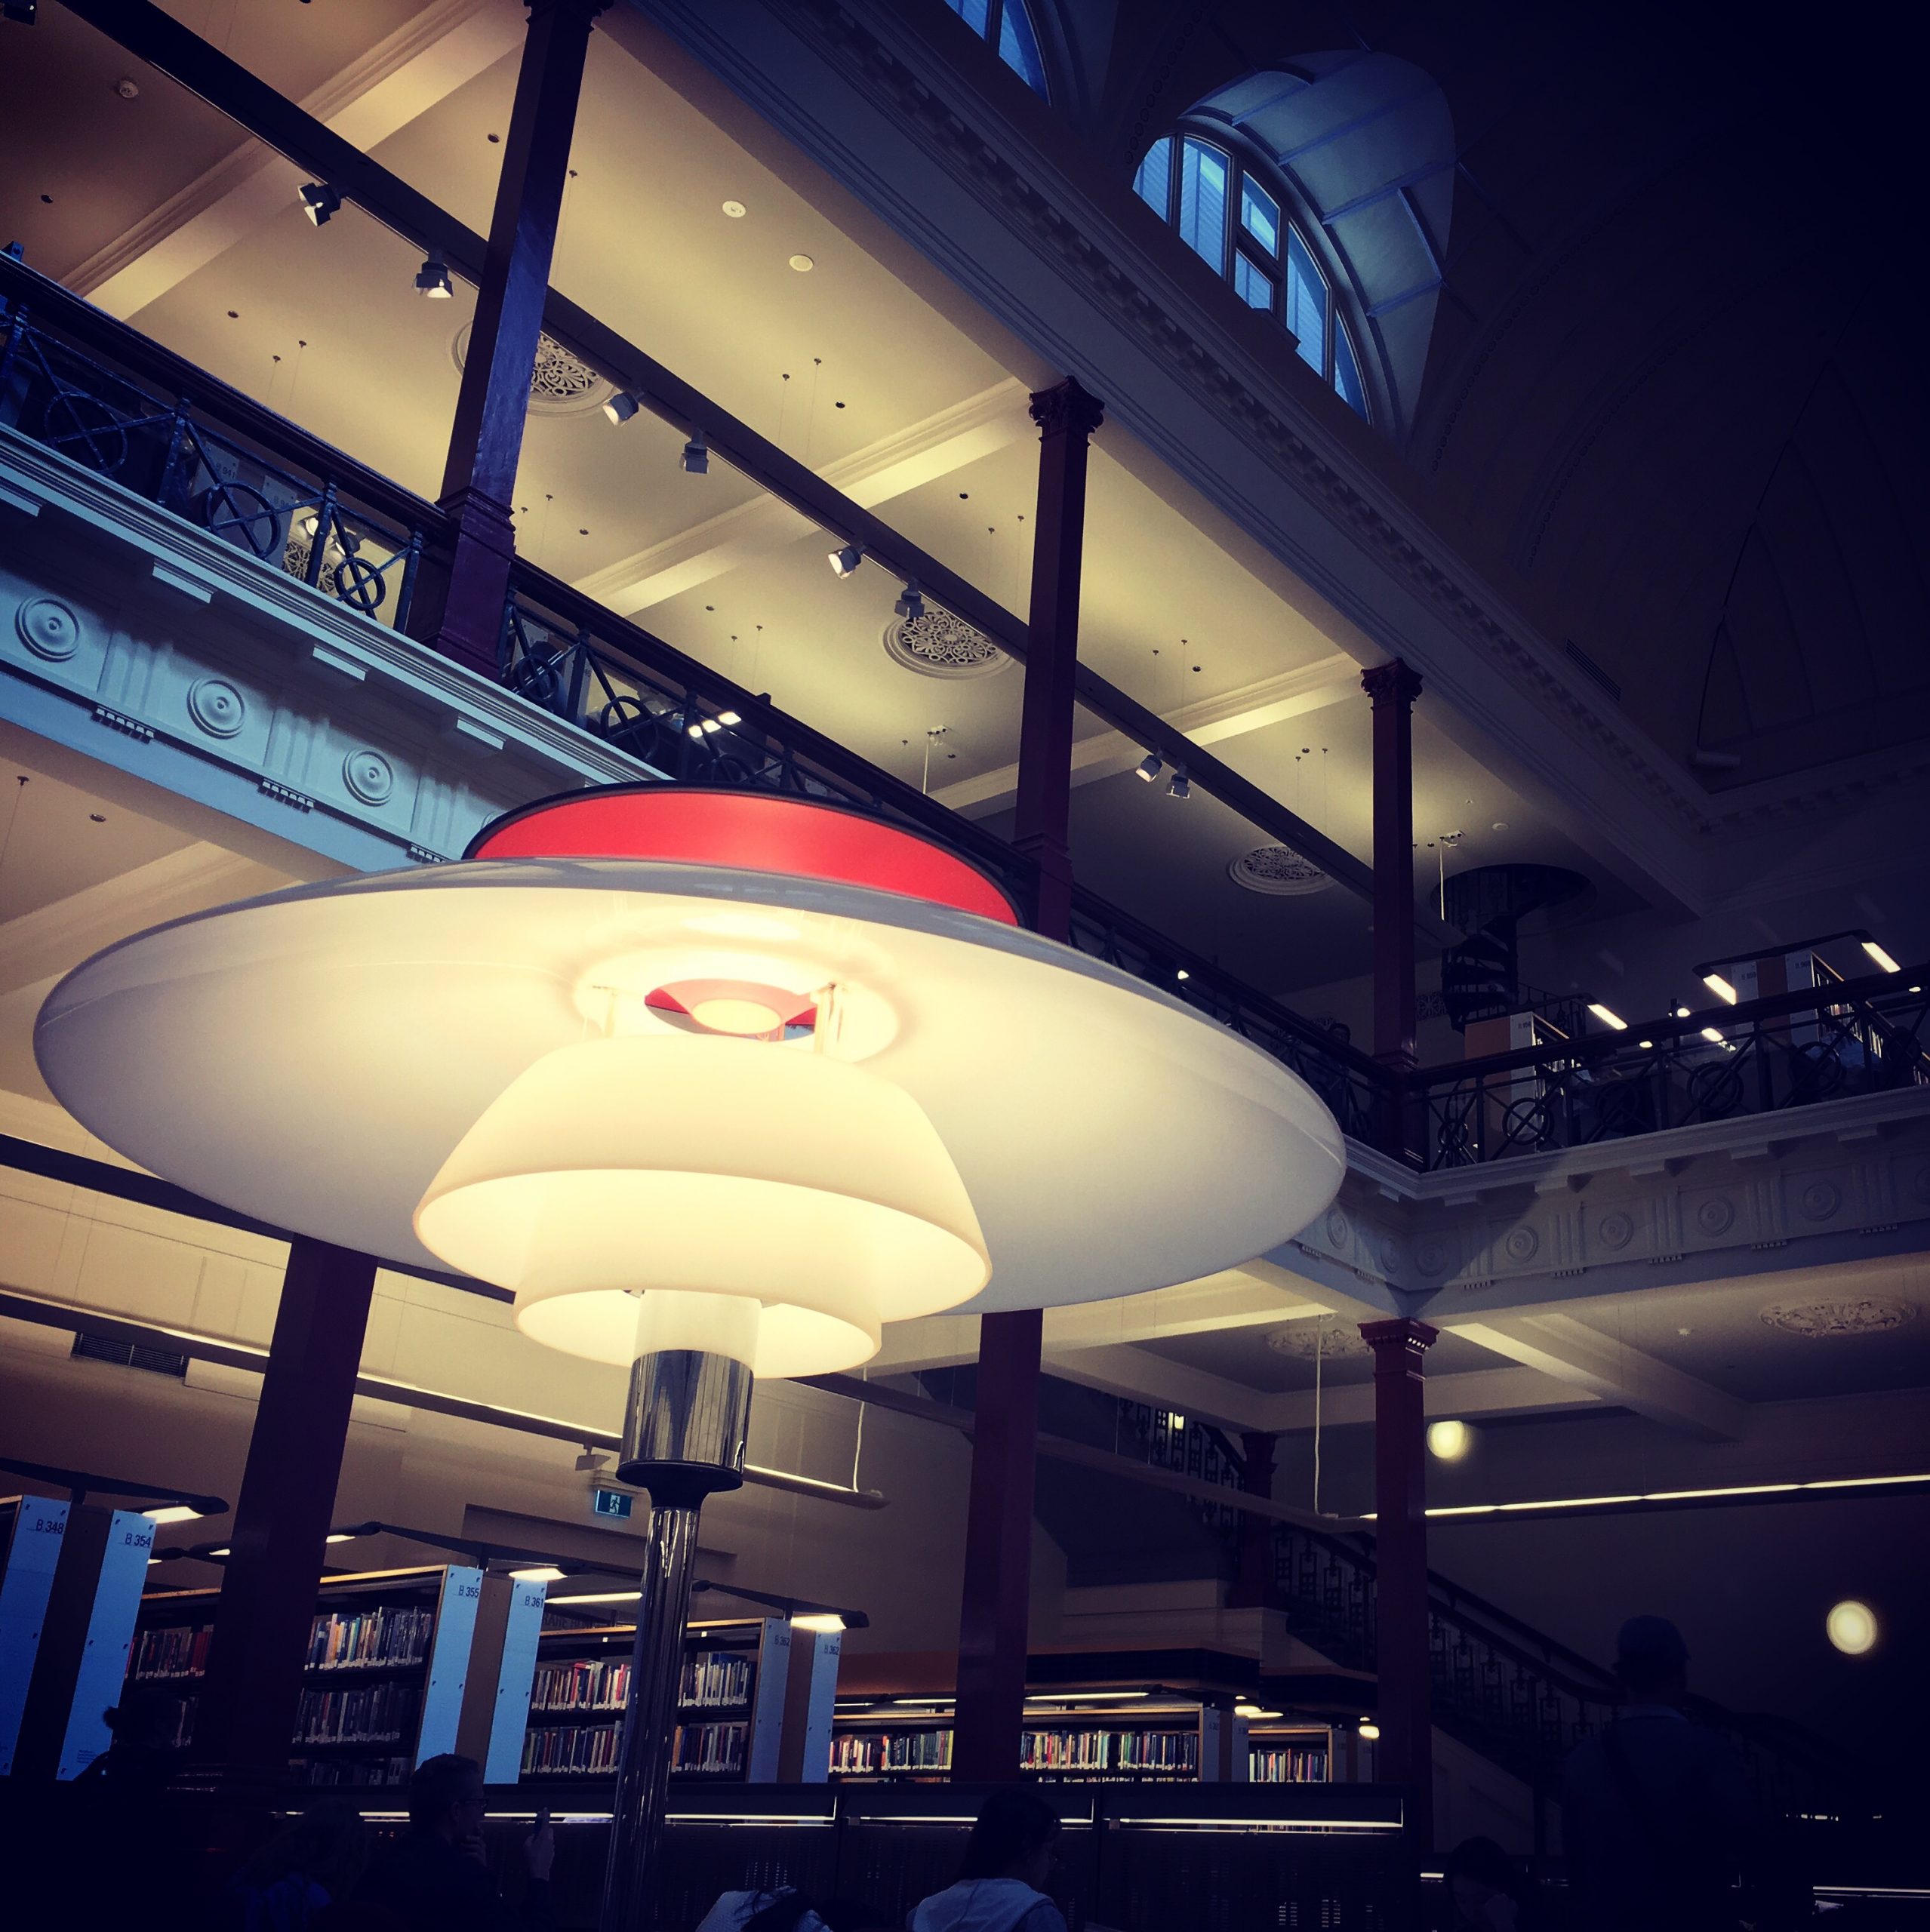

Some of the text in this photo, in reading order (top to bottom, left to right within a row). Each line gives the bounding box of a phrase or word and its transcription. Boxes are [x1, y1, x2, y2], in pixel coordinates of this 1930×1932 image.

[35, 1518, 65, 1534] B 348
[125, 1533, 152, 1548] B 354
[458, 1585, 480, 1598] B 355
[525, 1595, 544, 1608] B 361
[774, 1635, 780, 1645] B
[823, 1644, 829, 1654] B
